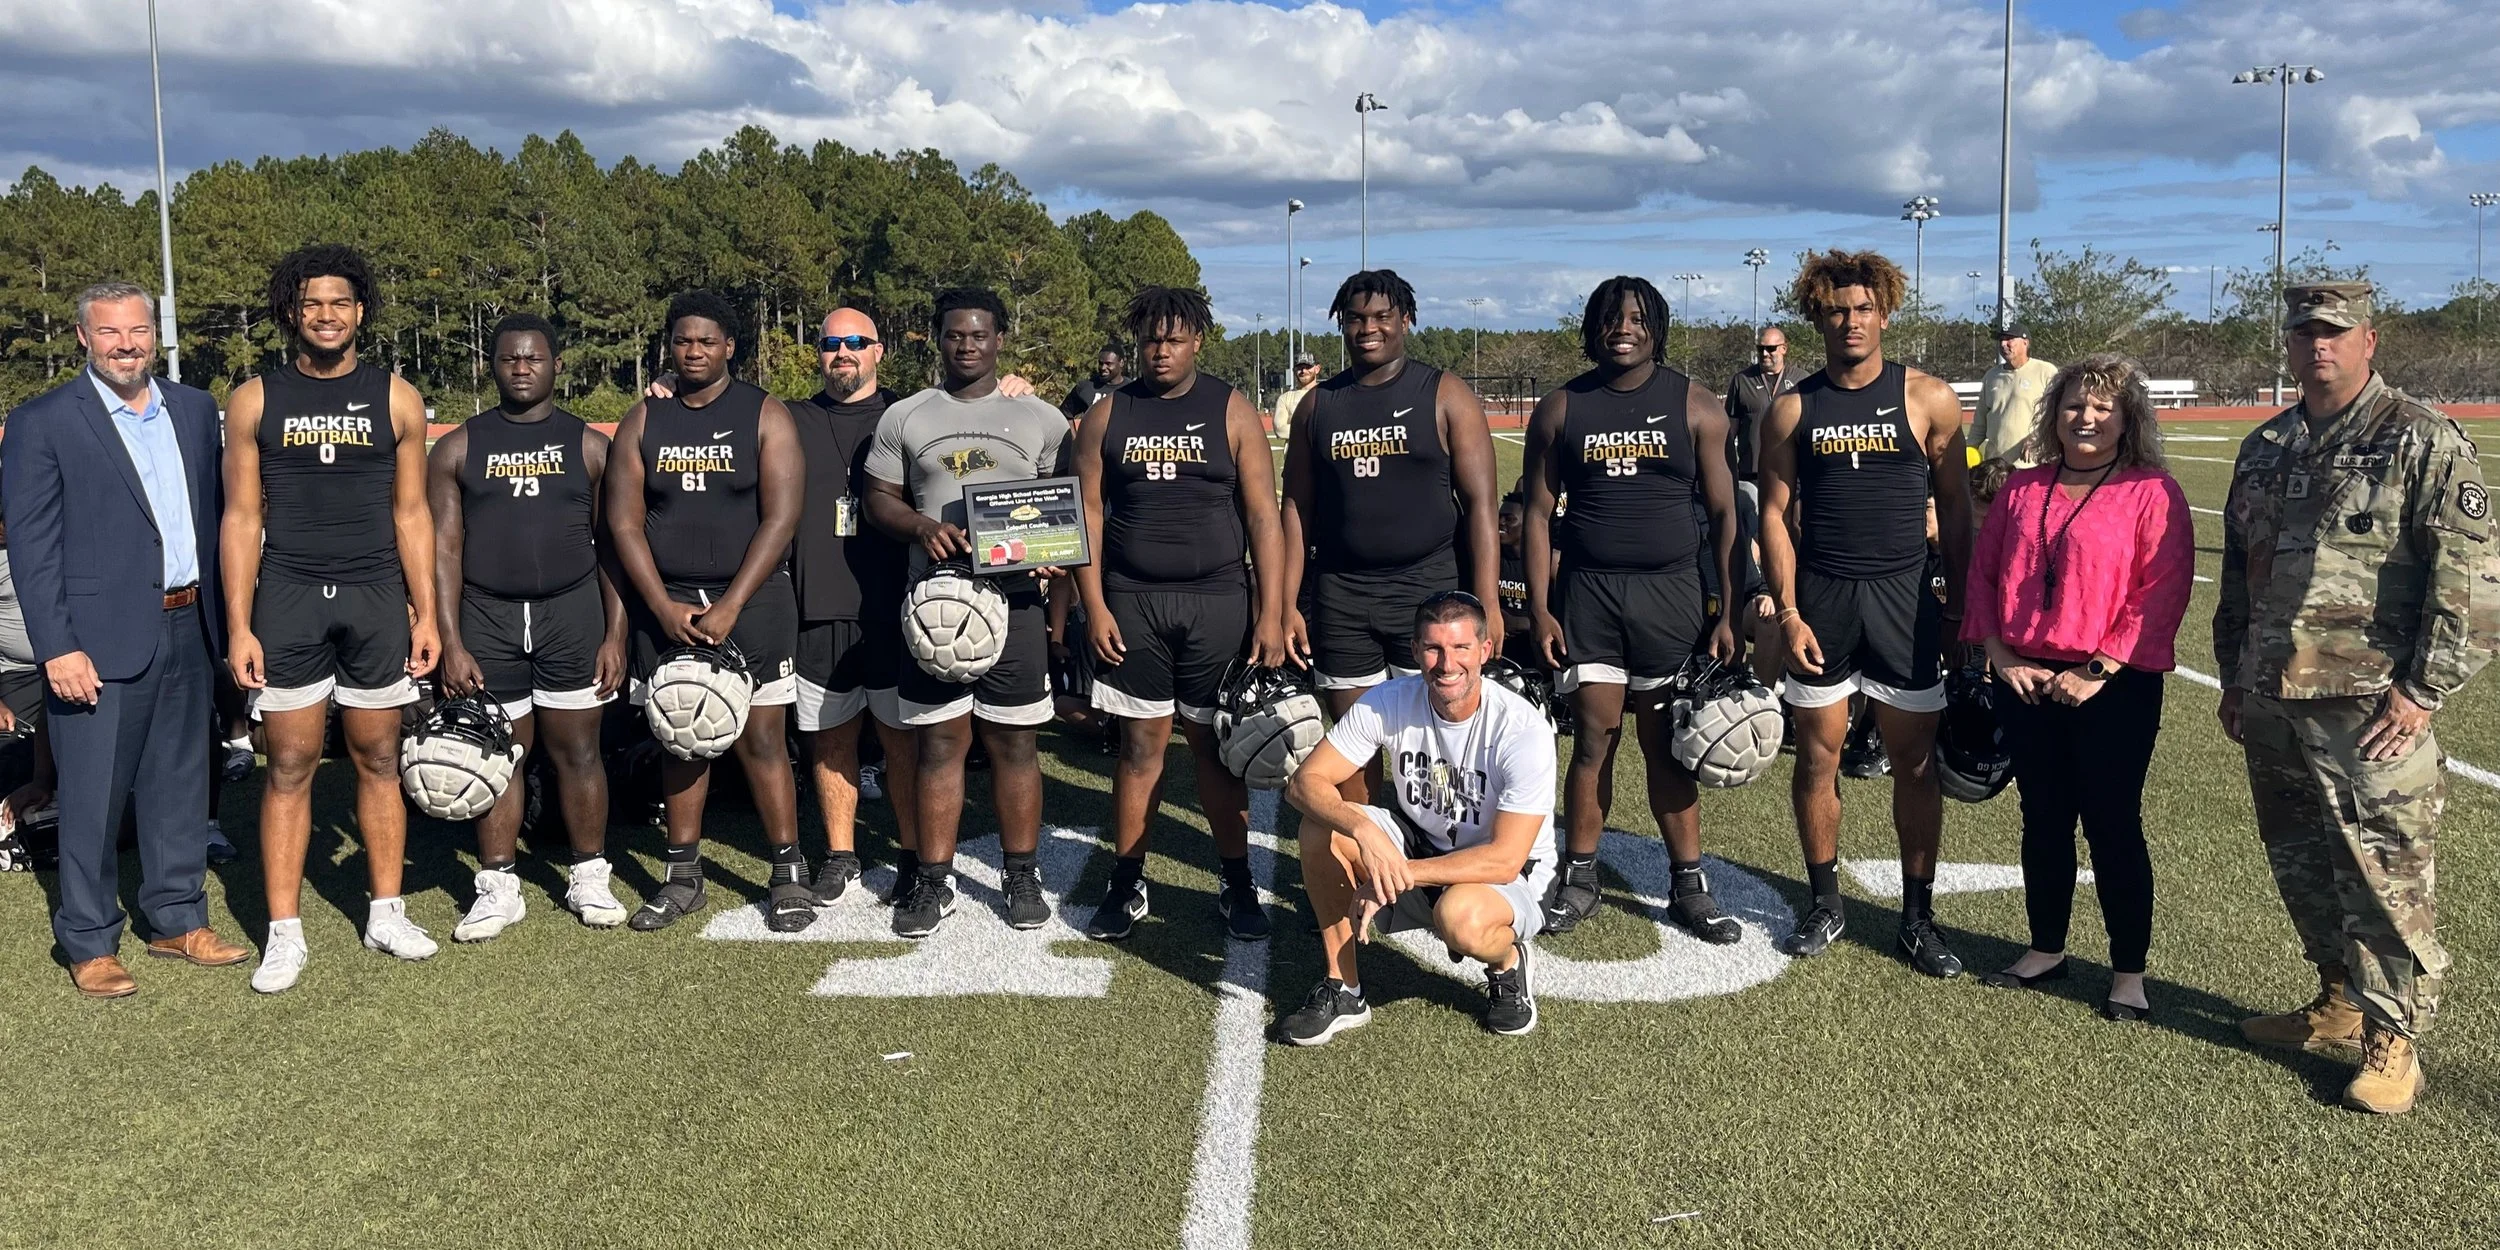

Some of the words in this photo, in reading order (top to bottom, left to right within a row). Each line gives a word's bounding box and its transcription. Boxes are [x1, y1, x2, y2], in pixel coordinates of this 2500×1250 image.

[283, 415, 373, 433] PACKER
[1811, 423, 1898, 442] PACKER
[283, 430, 374, 448] FOOTBALL
[1125, 435, 1205, 451] PACKER
[1330, 425, 1408, 447] PACKER
[1583, 430, 1668, 450] PACKER
[319, 443, 336, 464] 0
[658, 444, 734, 460] PACKER
[1121, 448, 1208, 464] FOOTBALL
[1331, 439, 1410, 461] FOOTBALL
[1583, 444, 1670, 463] FOOTBALL
[1812, 437, 1901, 456] FOOTBALL
[487, 450, 564, 467] PACKER
[656, 458, 736, 472] FOOTBALL
[1353, 456, 1380, 478] 60
[1605, 457, 1638, 477] 55
[485, 462, 566, 479] FOOTBALL
[509, 476, 540, 497] 73
[681, 472, 707, 492] 61
